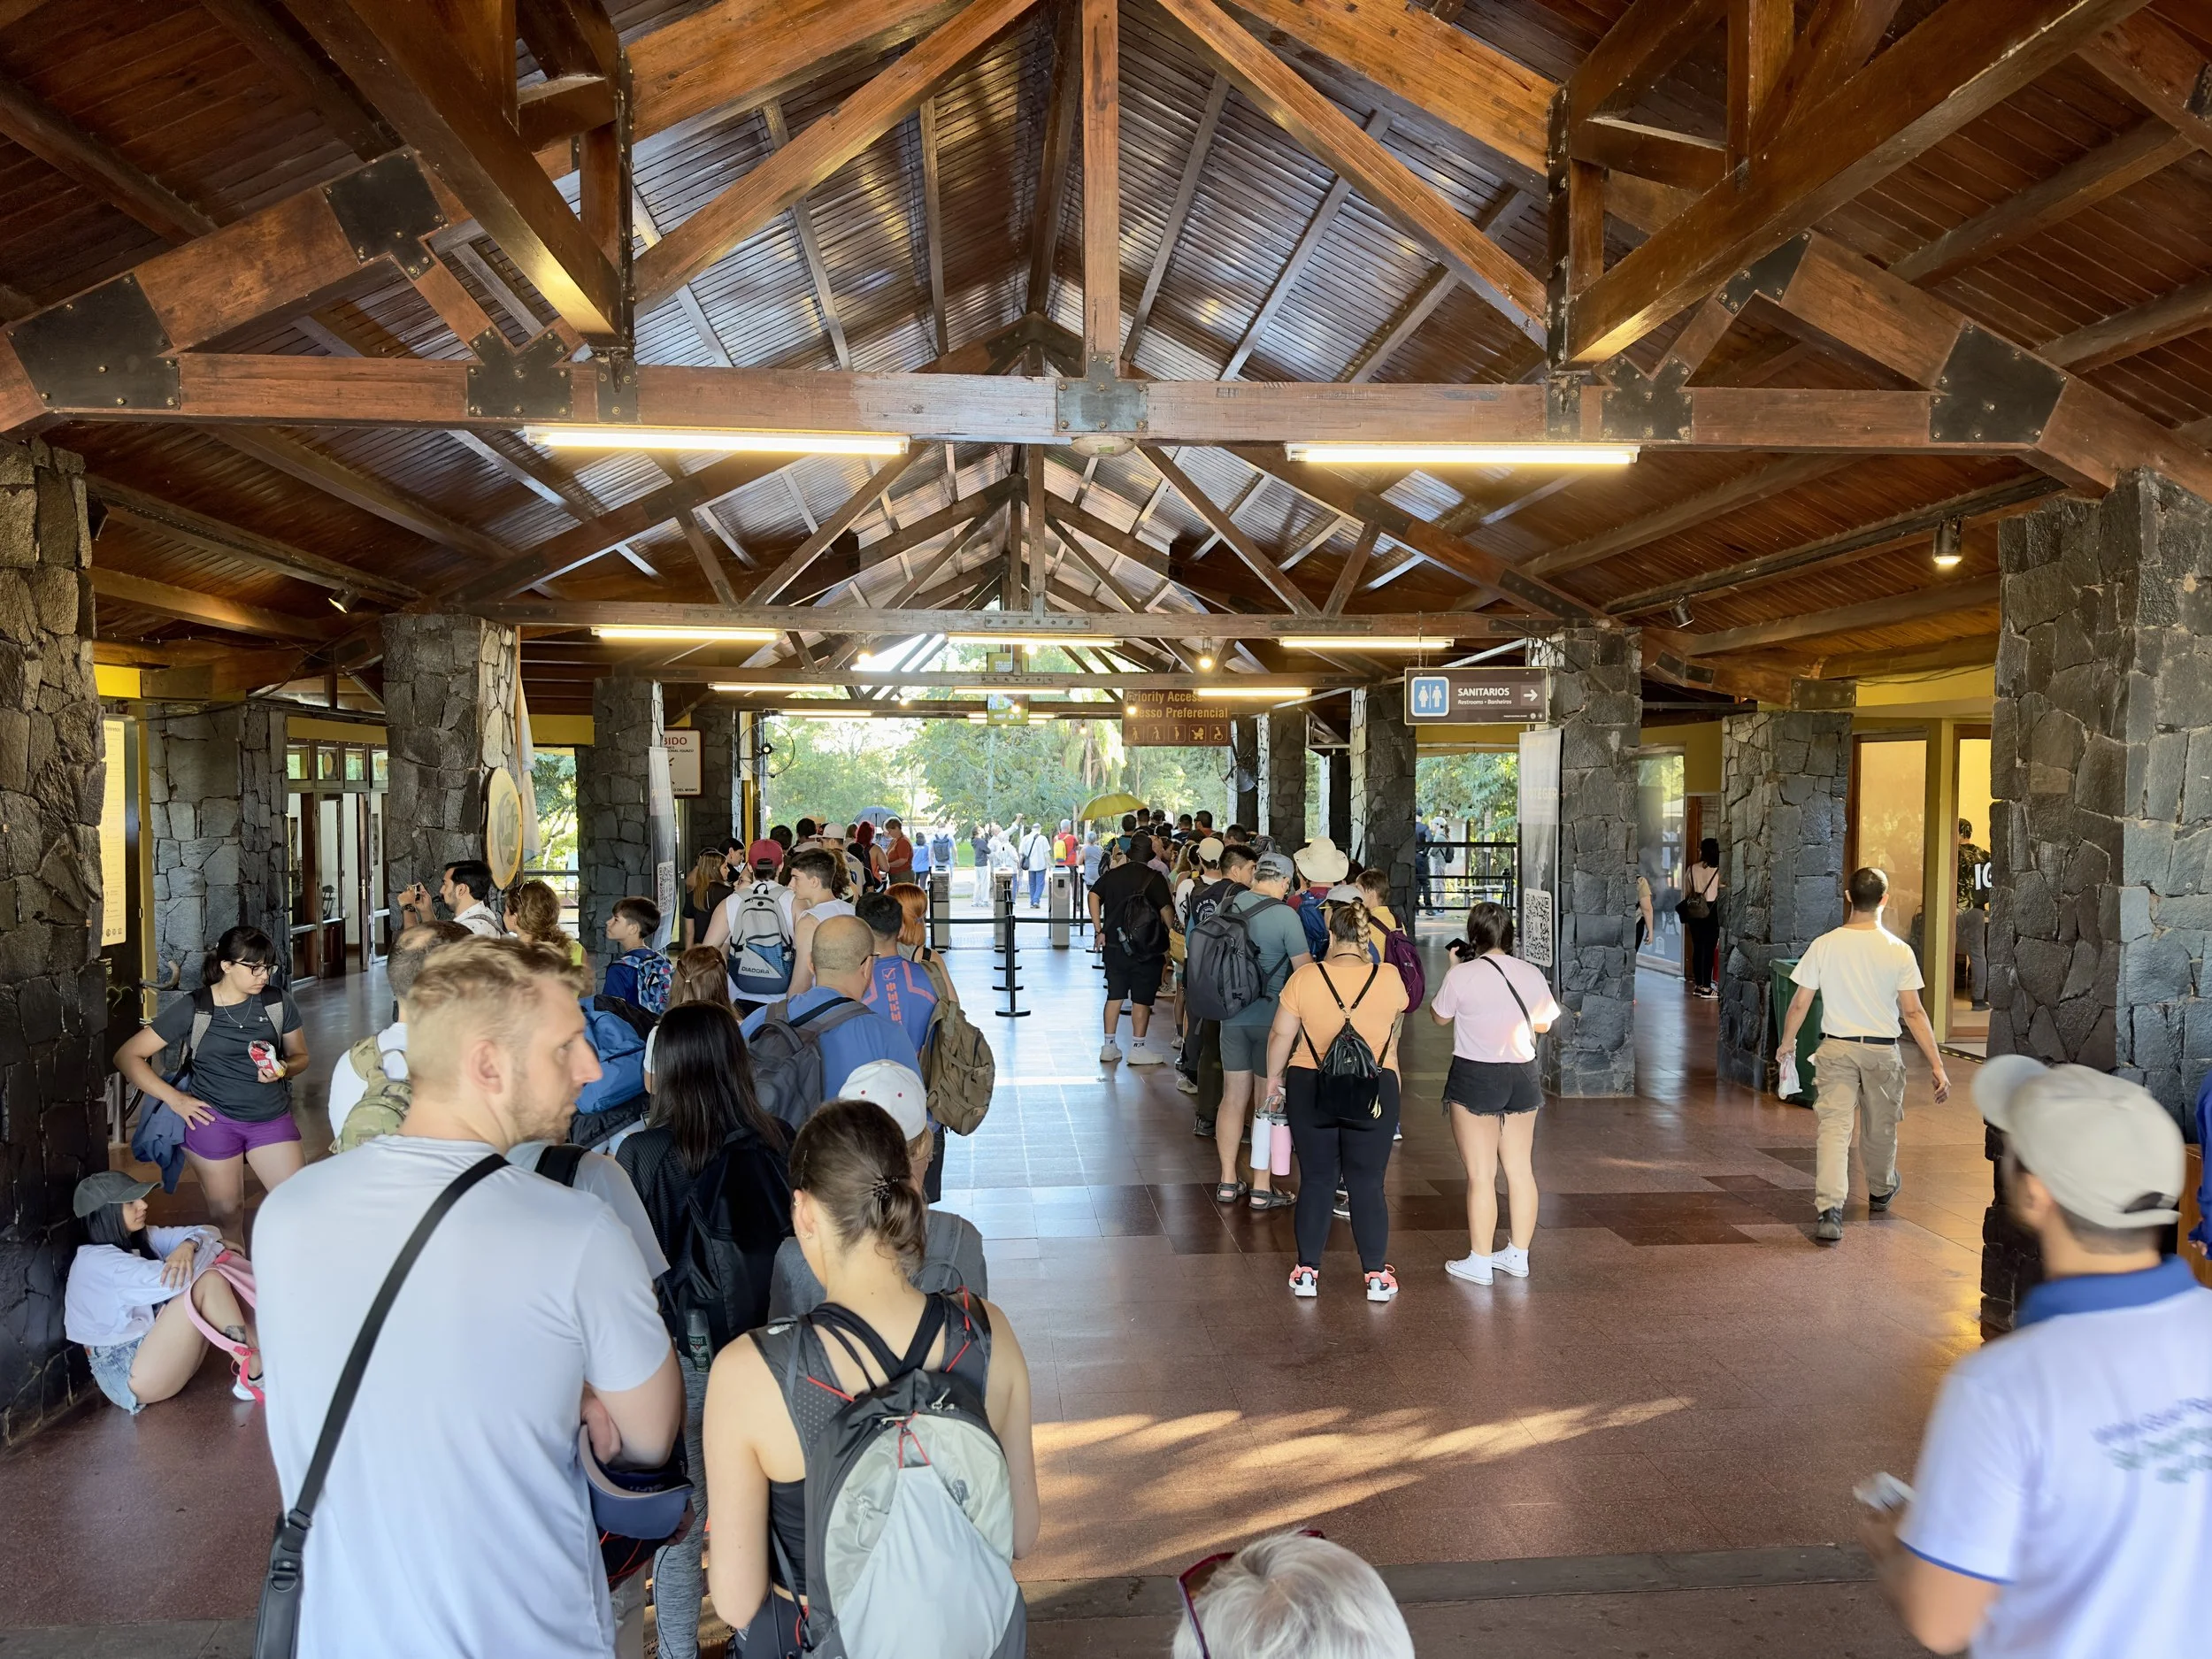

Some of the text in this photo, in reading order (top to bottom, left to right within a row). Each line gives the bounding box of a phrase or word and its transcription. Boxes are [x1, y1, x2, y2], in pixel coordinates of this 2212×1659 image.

[1126, 691, 1164, 704] Priority
[1457, 687, 1510, 697] SANITARIOS
[1165, 707, 1228, 718] Preferencial
